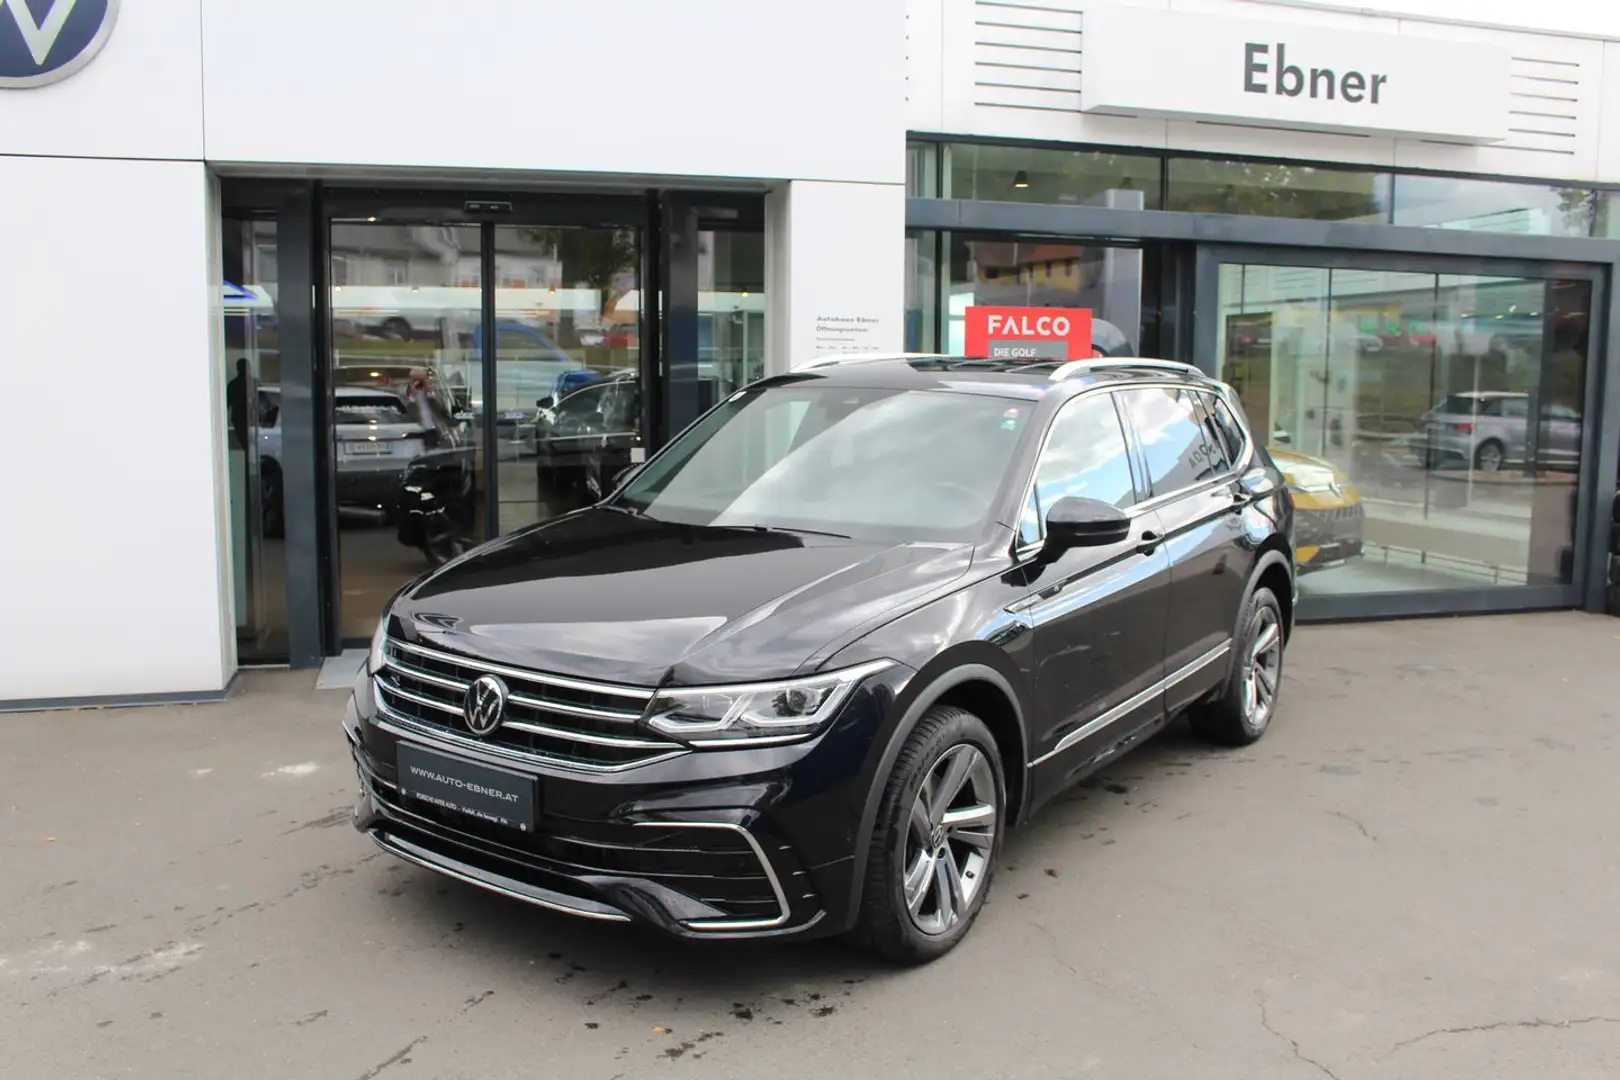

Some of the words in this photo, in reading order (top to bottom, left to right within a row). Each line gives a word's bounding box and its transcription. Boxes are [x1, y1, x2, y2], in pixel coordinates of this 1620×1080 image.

[1244, 42, 1388, 104] Ebner
[987, 314, 1070, 337] FALCO
[994, 347, 1009, 357] DIE
[1011, 347, 1037, 357] GOLF
[409, 765, 519, 803] WWW.AUTO-EBNER.AT
